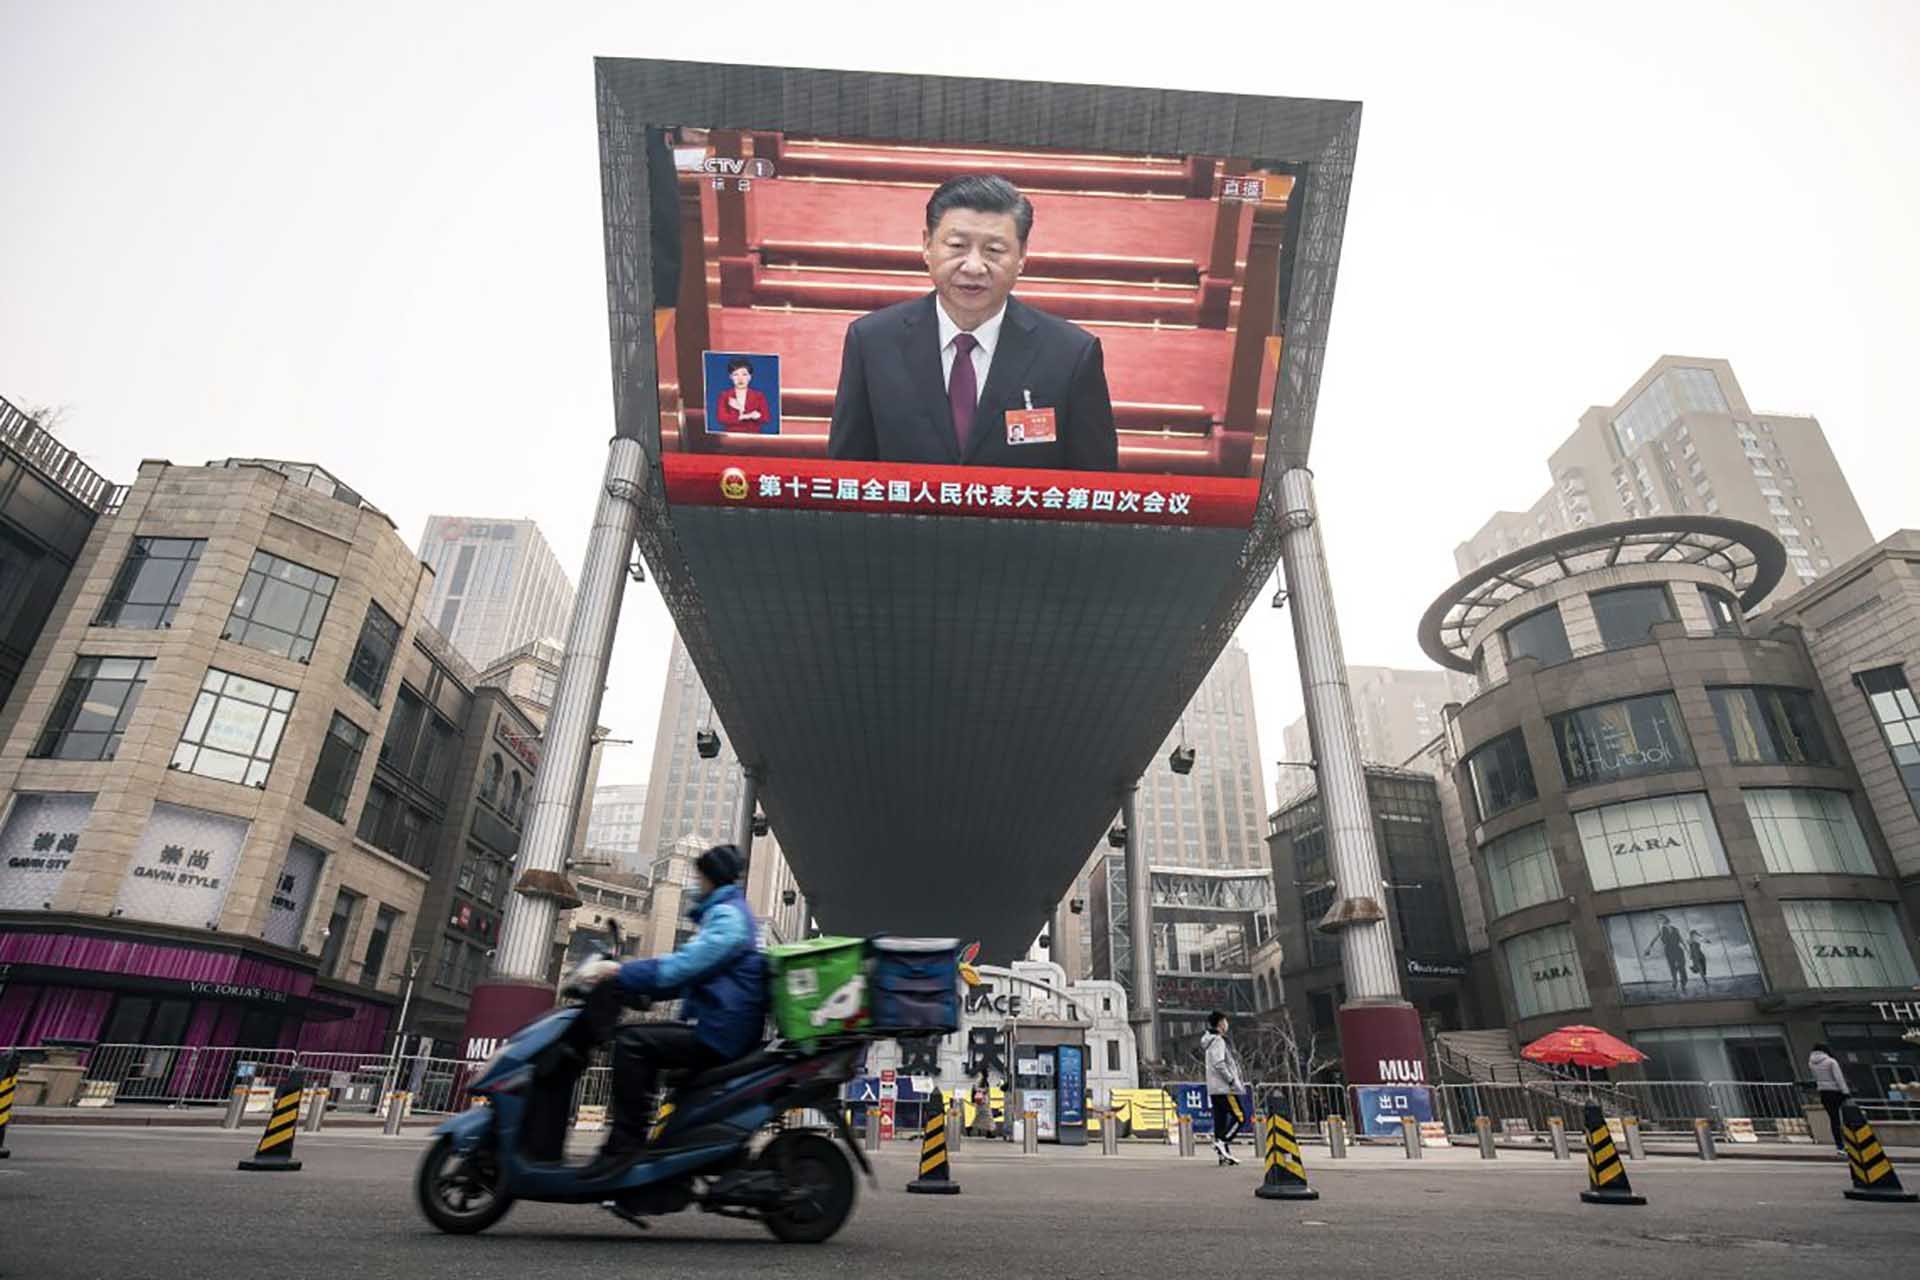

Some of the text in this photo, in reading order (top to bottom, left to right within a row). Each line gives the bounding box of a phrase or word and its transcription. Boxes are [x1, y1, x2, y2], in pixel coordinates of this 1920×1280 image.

[758, 474, 1192, 515] 第十三届全国人民代表大会第四次会议
[1613, 836, 1681, 856] ZARA
[133, 865, 221, 889] GAVIN STYLE
[1812, 944, 1875, 959] ZARA
[1532, 965, 1573, 982] ZARA
[957, 992, 1022, 1017] LACE
[1378, 1060, 1424, 1081] MUJI
[1378, 1094, 1409, 1109] 出口
